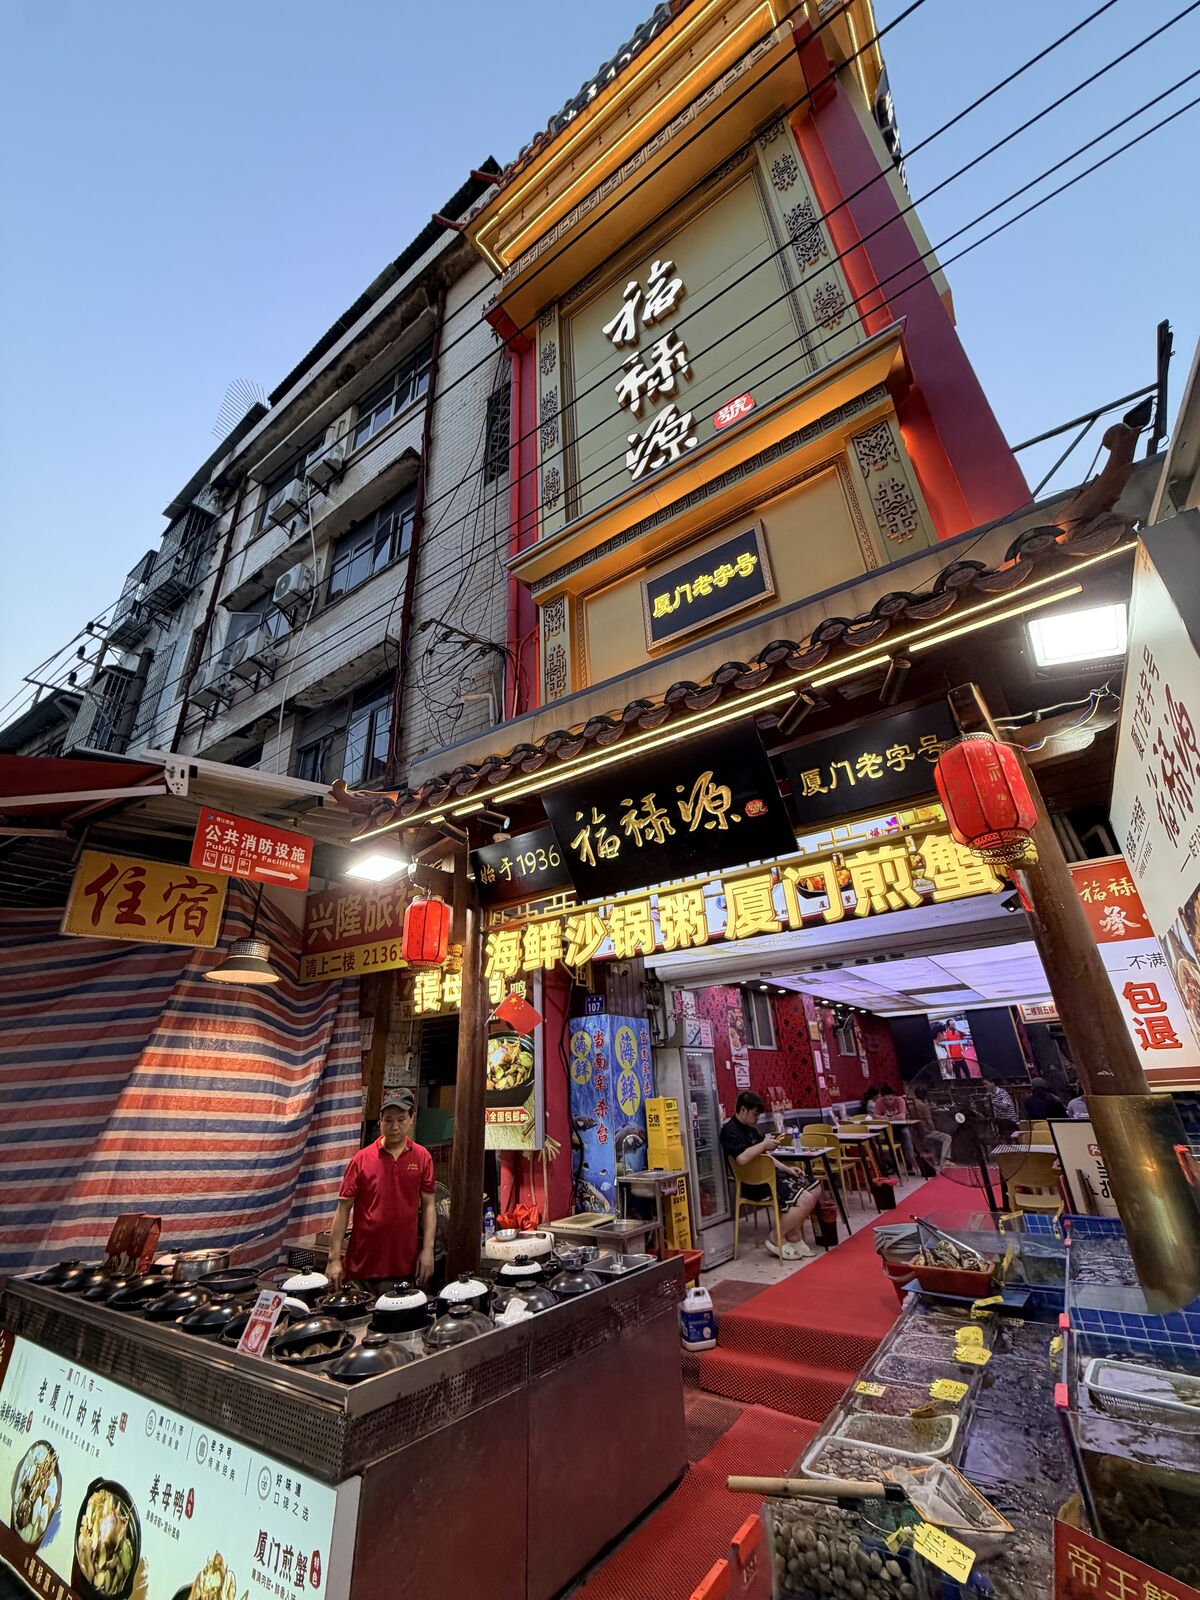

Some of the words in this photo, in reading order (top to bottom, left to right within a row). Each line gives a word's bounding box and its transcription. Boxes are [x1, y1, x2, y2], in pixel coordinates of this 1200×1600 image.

[602, 260, 698, 481] 福禄源
[653, 552, 758, 618] 厦门老字号
[801, 734, 944, 797] 厦门老字号
[204, 824, 306, 864] 公共消防设施
[571, 770, 742, 867] 福禄源
[205, 841, 236, 855] Public
[239, 849, 258, 861] Fire
[261, 855, 301, 870] Facilities
[84, 861, 218, 938] 住宿
[484, 890, 708, 980] 海鲜沙锅粥
[724, 834, 1005, 941] 厦门煎蟹
[305, 951, 356, 979] 请上二楼
[362, 944, 403, 966] 2136
[588, 1001, 601, 1013] 107
[1122, 981, 1183, 1052] 包退
[573, 1034, 591, 1081] 海鲜
[592, 1030, 609, 1145] 当面宰杀台
[618, 1031, 638, 1106] 海鲜
[489, 1111, 520, 1123] 全国包邮
[37, 1377, 119, 1447] 老厦门的味道
[211, 1439, 232, 1461] 老字号
[149, 1474, 185, 1522] 姜母鸭
[276, 1472, 302, 1498] 好味道
[253, 1528, 309, 1592] 厦门煎蟹
